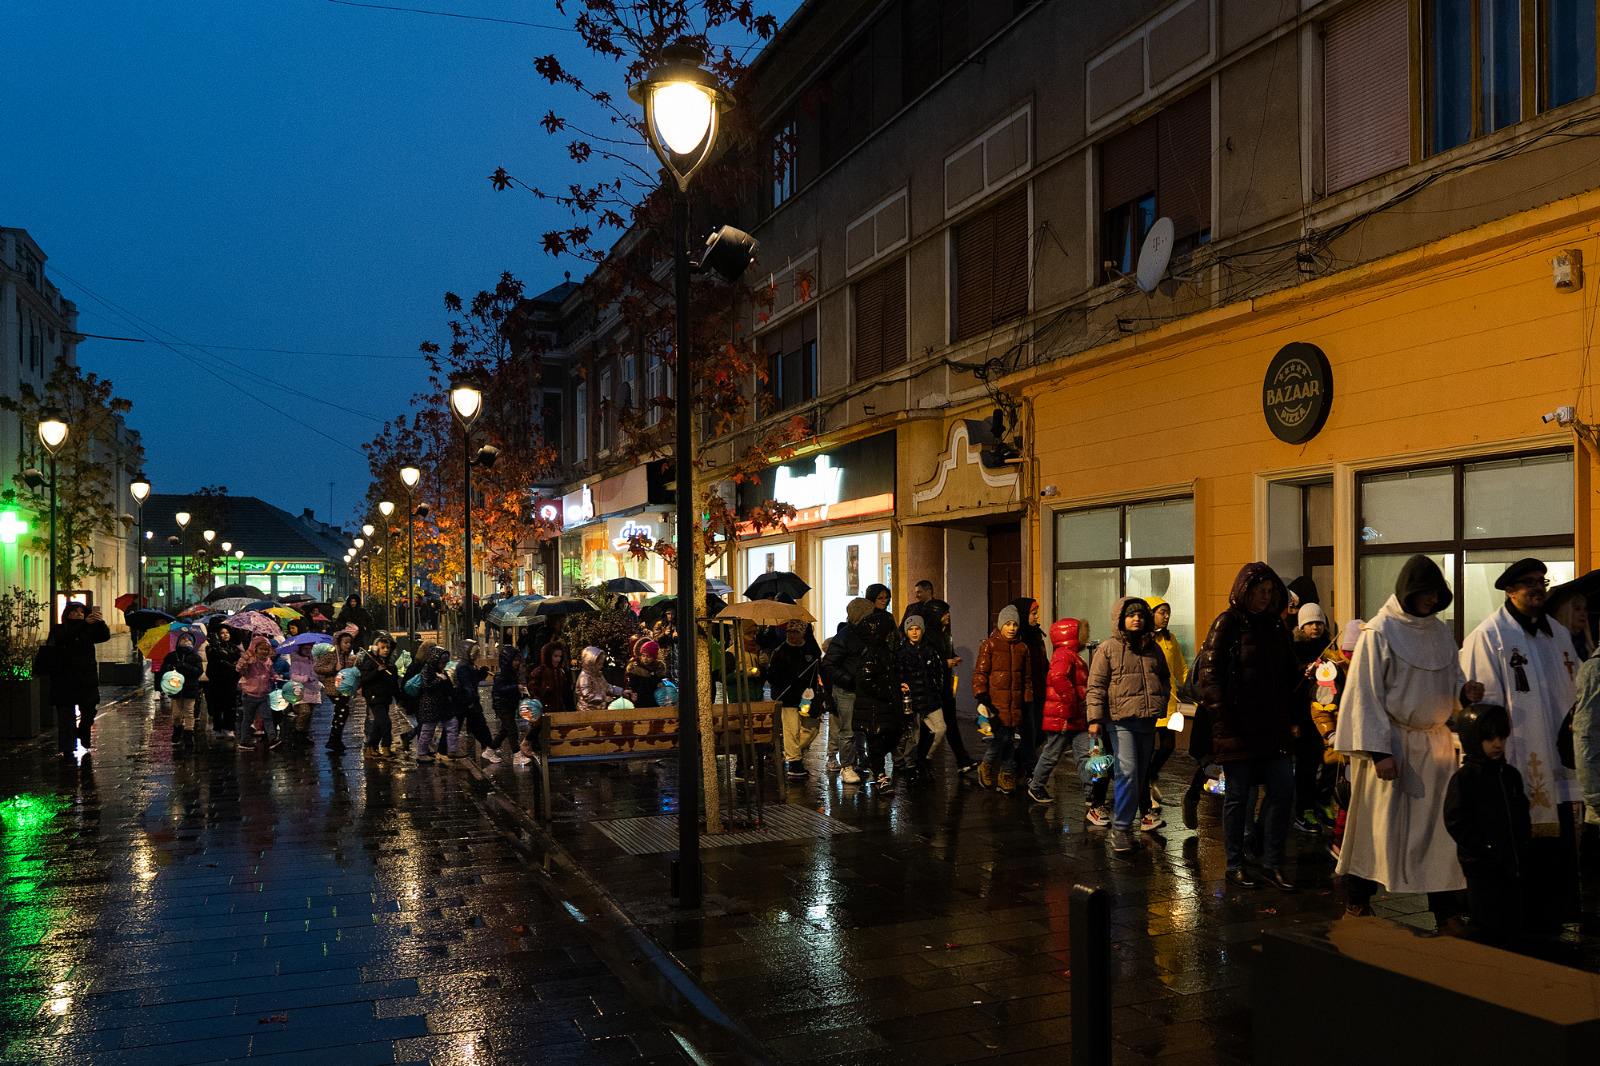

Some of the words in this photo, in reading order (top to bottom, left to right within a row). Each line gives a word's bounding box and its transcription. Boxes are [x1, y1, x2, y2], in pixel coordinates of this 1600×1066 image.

[1266, 379, 1320, 406] BAZAAR
[1280, 407, 1307, 423] PIZZA
[622, 523, 649, 539] dm
